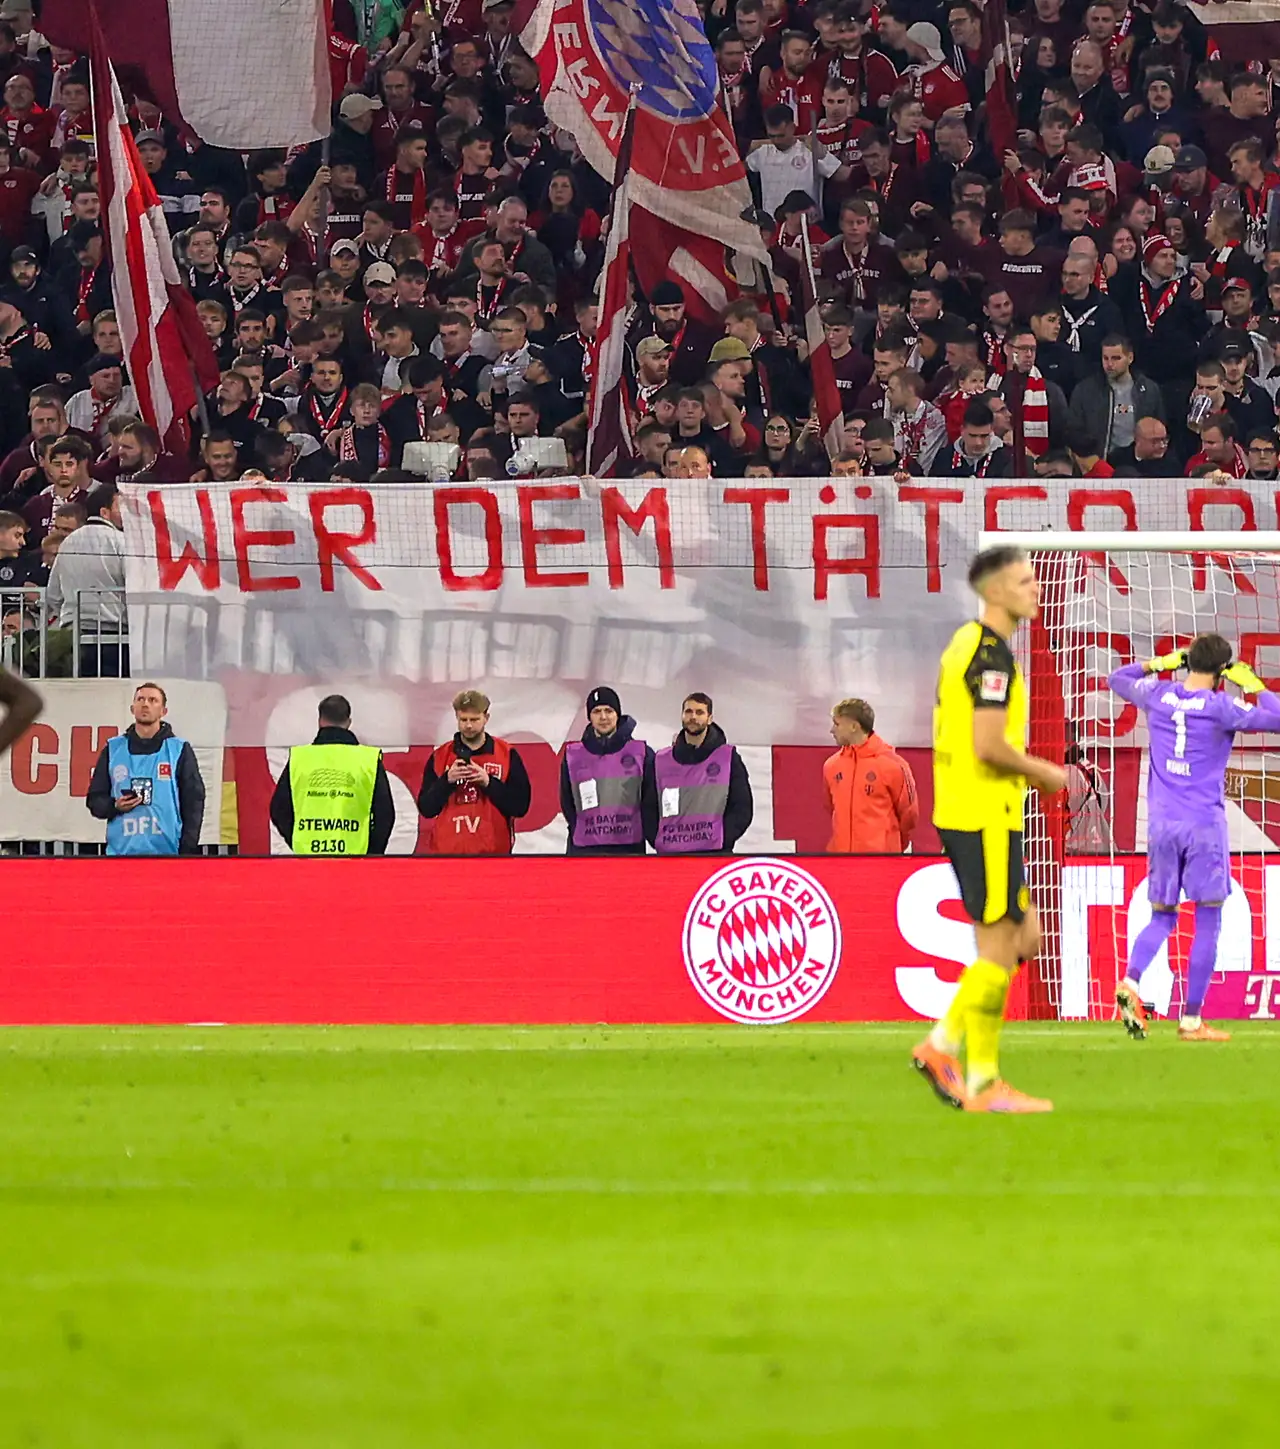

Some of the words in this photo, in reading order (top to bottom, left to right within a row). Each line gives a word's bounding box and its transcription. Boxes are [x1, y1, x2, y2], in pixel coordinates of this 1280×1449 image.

[147, 484, 384, 593] WER
[433, 484, 676, 593] DEM
[1171, 711, 1187, 759] 1
[298, 818, 360, 832] STEWARD
[452, 815, 481, 834] TV
[584, 824, 633, 836] MATCHDAY
[677, 821, 713, 832] BAYERN
[311, 839, 346, 853] 8130
[662, 832, 714, 844] MATCHDAY
[697, 893, 727, 930] FC
[727, 871, 827, 930] BAYERN
[698, 957, 826, 1013] MÜNCHEN
